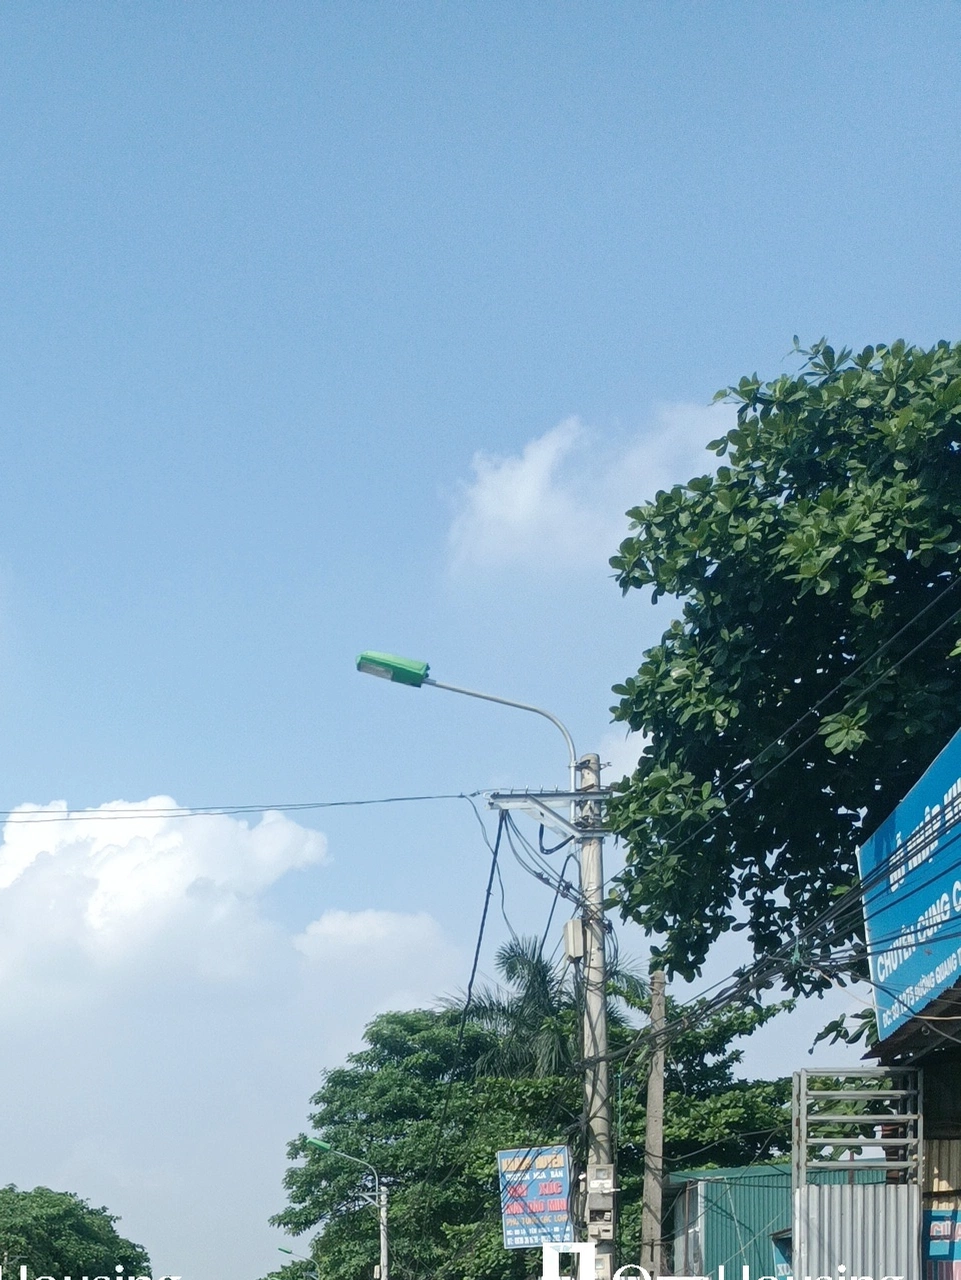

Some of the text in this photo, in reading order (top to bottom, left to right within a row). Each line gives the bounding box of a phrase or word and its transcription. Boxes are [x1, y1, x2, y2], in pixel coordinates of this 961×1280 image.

[878, 924, 916, 982] CHUYÊN
[917, 893, 951, 943] CUNG
[539, 1180, 563, 1196] XÚC
